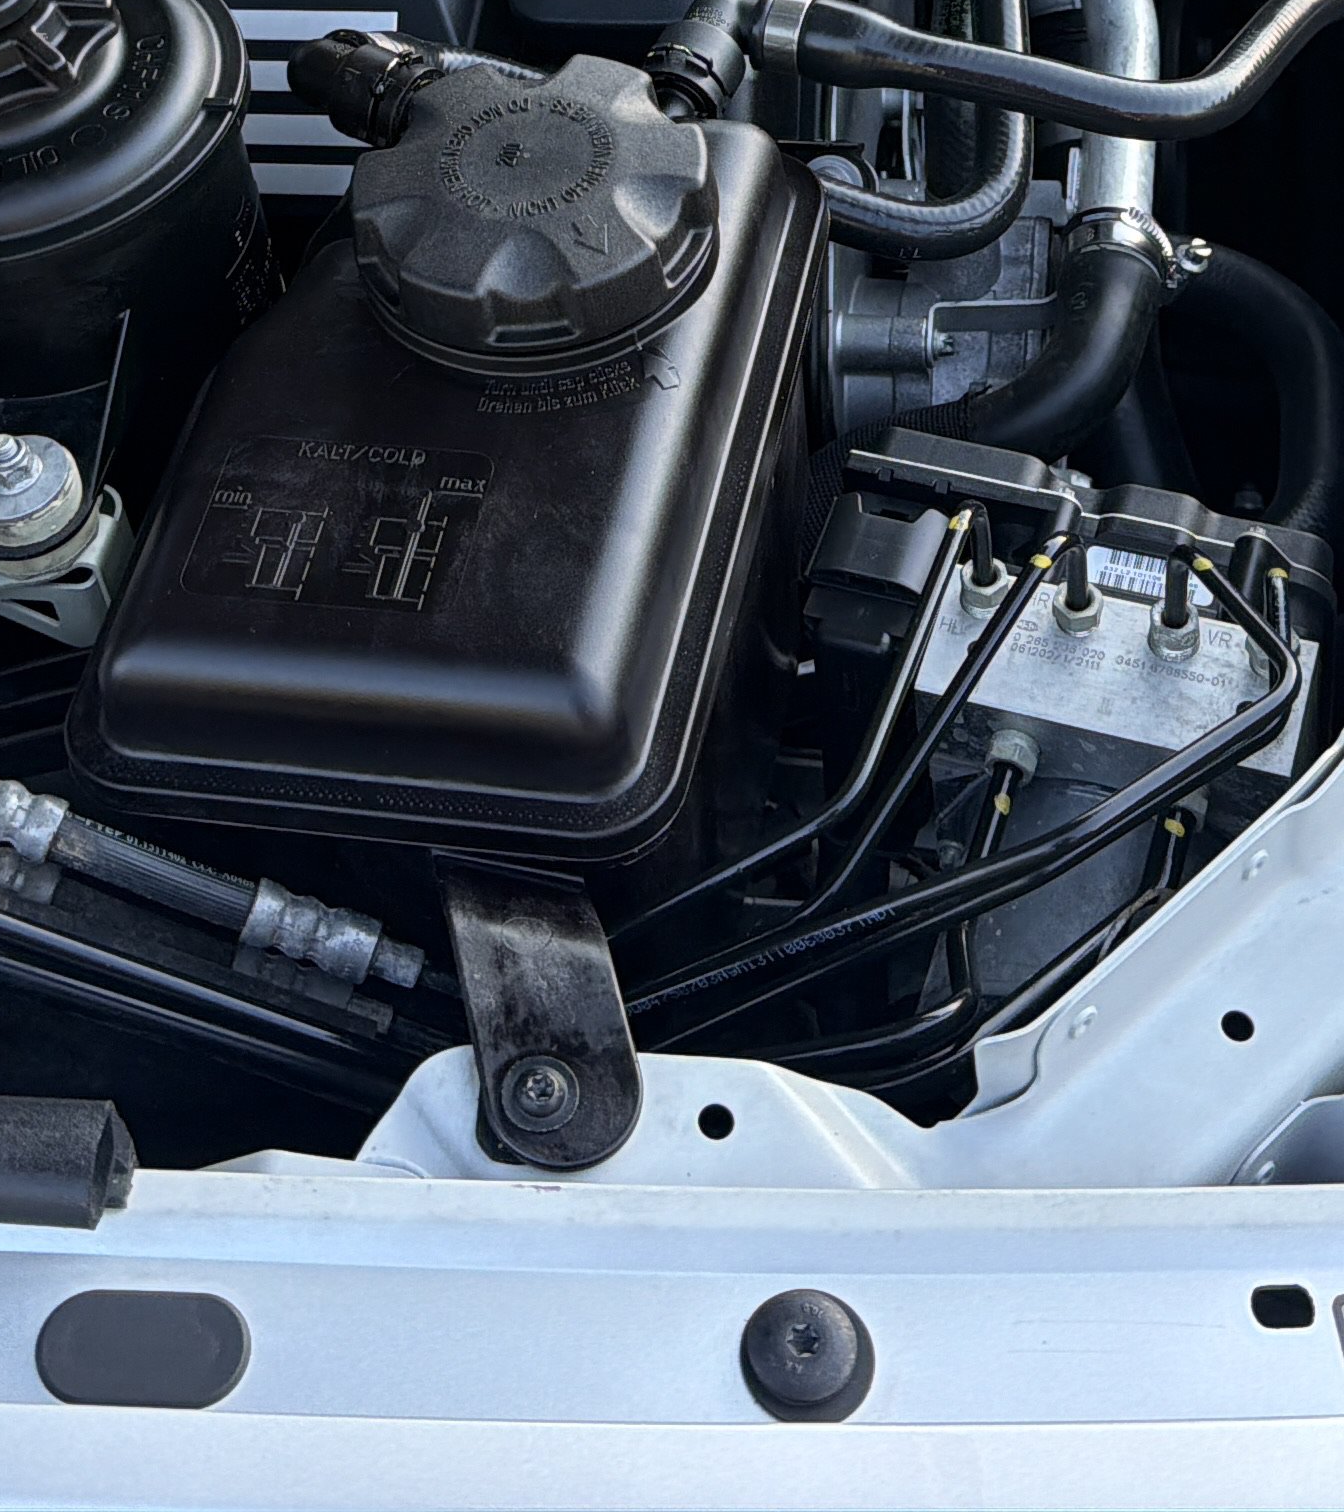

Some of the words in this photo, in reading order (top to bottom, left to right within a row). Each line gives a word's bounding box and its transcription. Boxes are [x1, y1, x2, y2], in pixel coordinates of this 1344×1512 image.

[470, 103, 505, 127] NOT
[508, 97, 531, 114] DO
[8, 144, 60, 175] OIL
[508, 196, 560, 218] NICHT
[476, 396, 533, 414] Drehen
[537, 395, 560, 413] bis
[563, 392, 596, 410] zum
[598, 377, 641, 402] Klick
[485, 379, 515, 396] Turn
[438, 476, 487, 494] max
[214, 486, 254, 506] min
[1207, 629, 1233, 648] VR
